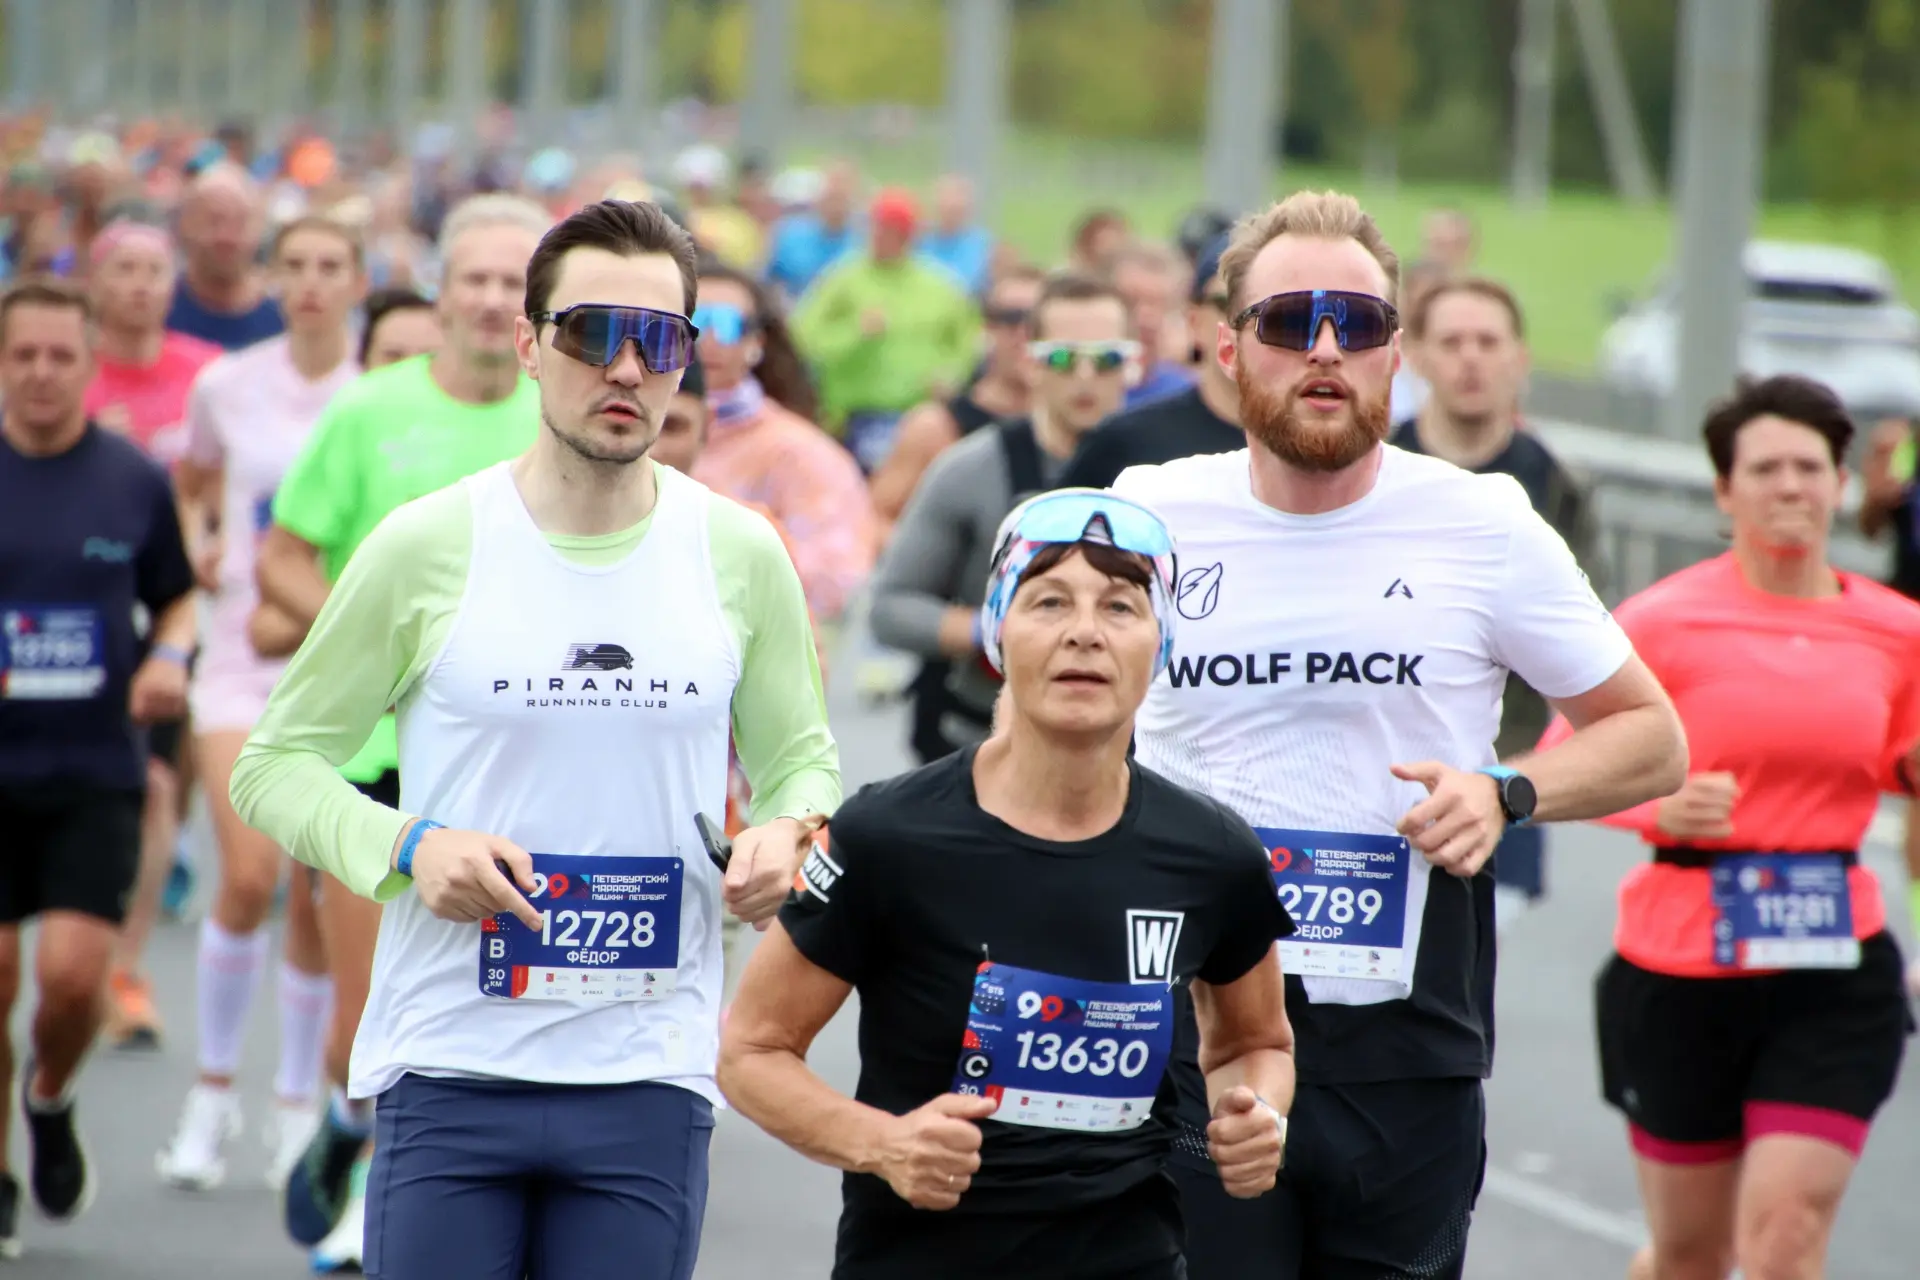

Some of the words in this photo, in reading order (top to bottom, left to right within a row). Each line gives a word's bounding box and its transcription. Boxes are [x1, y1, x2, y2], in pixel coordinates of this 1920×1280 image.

[1169, 653, 1291, 688] WOLF
[1306, 652, 1424, 686] PACK
[494, 678, 699, 695] PIRANHA
[527, 699, 611, 707] RUNNING
[620, 699, 667, 708] CLUB
[1315, 849, 1395, 863] ПЕТЕРБУРГСКИЙ
[1315, 859, 1365, 869] МАРАФОН
[592, 873, 669, 884] ПЕТЕРБУРГСКИЙ
[1315, 868, 1347, 876] ПУШКИН
[1353, 871, 1394, 879] ПЕТЕРБУРГ
[592, 885, 641, 893] МАРАФОН
[1278, 883, 1382, 925] 2789
[541, 910, 655, 948] 12728
[1136, 920, 1174, 976] W
[567, 948, 620, 965] ФЁДОР
[488, 969, 505, 980] 30
[1017, 991, 1064, 1022] 99
[1089, 1000, 1162, 1012] ПЕТЕРБУРГСКИЙ
[1086, 1011, 1136, 1021] МАРАФОН
[1017, 1031, 1149, 1078] 13630
[958, 1084, 979, 1096] 30
